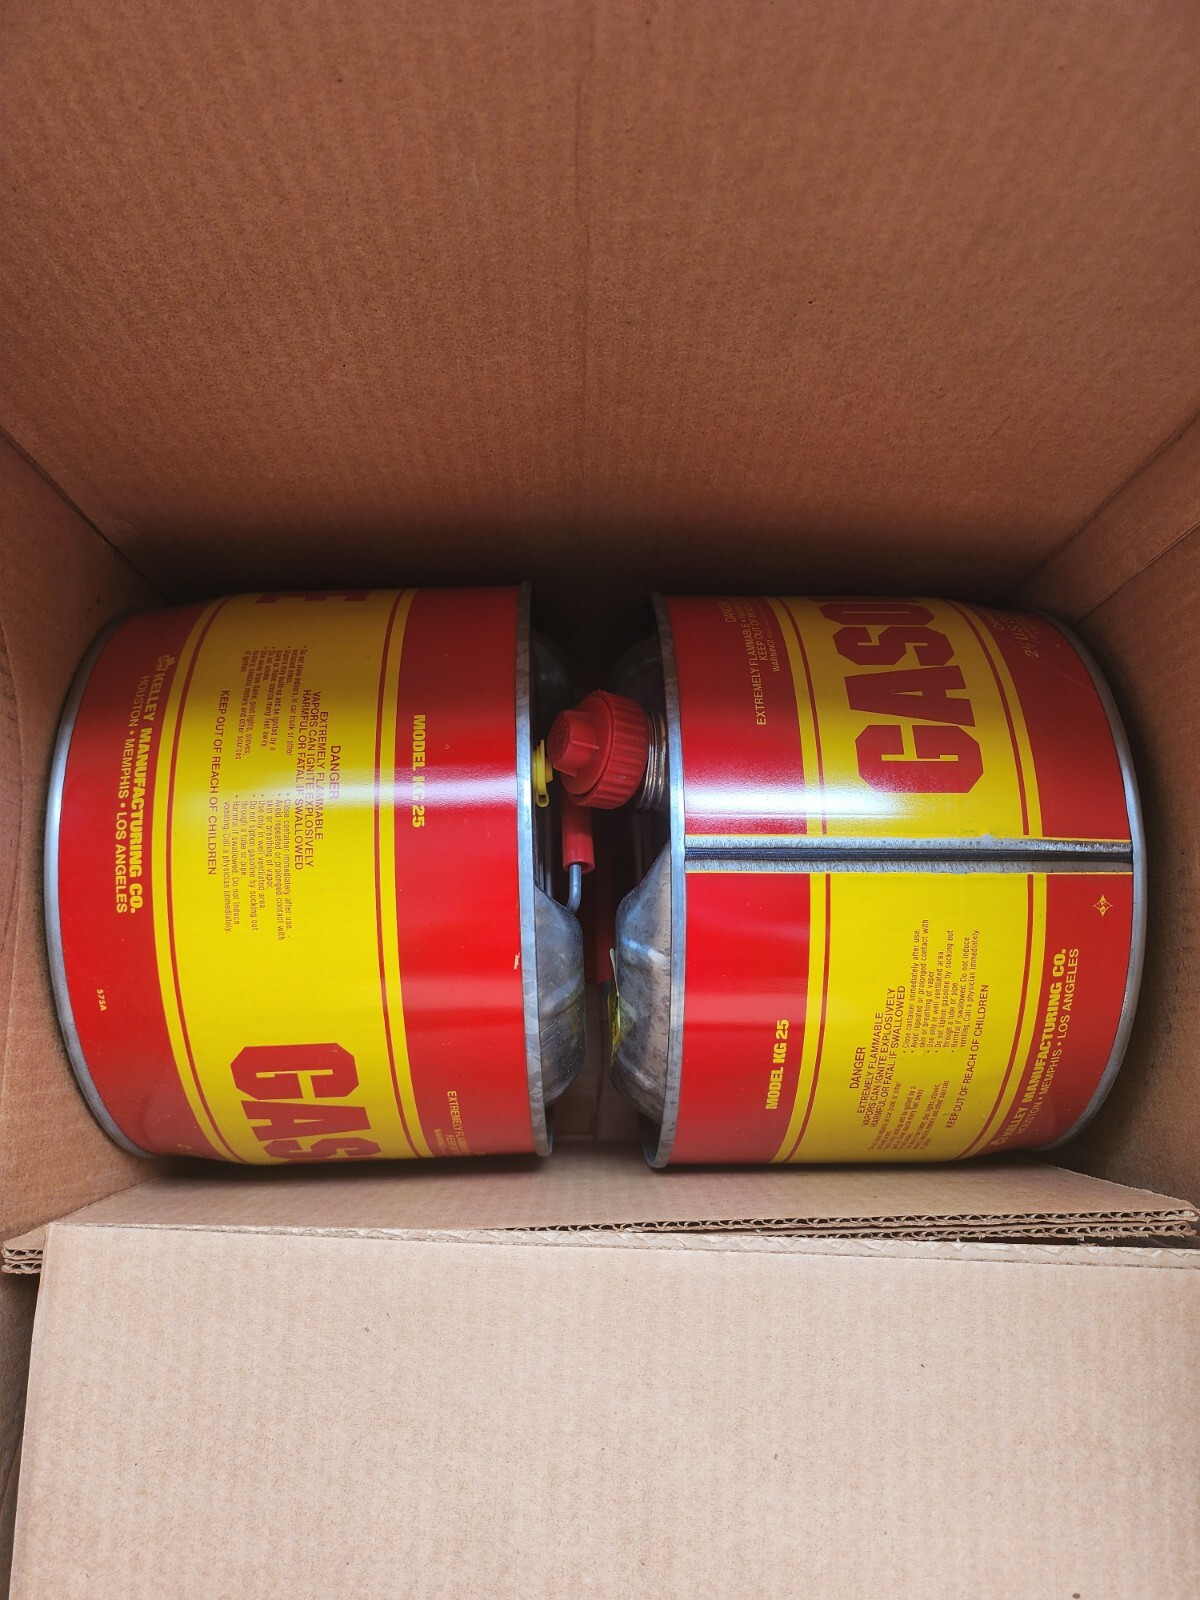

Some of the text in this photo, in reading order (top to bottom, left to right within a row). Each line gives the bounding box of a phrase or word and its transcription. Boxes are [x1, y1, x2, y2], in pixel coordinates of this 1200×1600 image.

[741, 623, 758, 666] FLAMMABLE
[750, 668, 766, 725] EXTREMELY
[298, 690, 311, 733] HARMFUL
[298, 735, 306, 749] OR
[296, 753, 305, 782] FATAL
[305, 692, 321, 867] VAPORS CAN IGNITE EXPLOSIVELY
[315, 712, 328, 840] EXTREMELY FLAMMABLE
[330, 746, 341, 799] DANGER
[412, 715, 425, 828] MODEL KG 25
[115, 675, 150, 913] HOUSTON MEMPHIS LOS ANGELES
[129, 672, 165, 913] KELLEY MANUFACTURING CO.
[208, 690, 230, 875] KEEP OUT OF REACH OF CHILDREN
[296, 786, 303, 795] IF
[240, 801, 248, 826] through
[250, 801, 257, 809] Do
[258, 801, 266, 813] Use
[266, 800, 274, 813] skin
[248, 824, 256, 846] siphon
[265, 826, 274, 857] breathing
[274, 820, 282, 849] repeated
[294, 799, 303, 870] SWALLOWED
[222, 856, 230, 888] physician
[248, 849, 256, 877] gasoline
[232, 877, 239, 886] Do
[249, 880, 256, 888] by
[274, 862, 282, 895] prolonged
[250, 891, 258, 917] sucking
[276, 898, 284, 923] contact
[1062, 948, 1078, 1011] ANGELES
[96, 989, 107, 1011] 575A
[974, 985, 988, 1036] CHILDREN
[880, 989, 895, 1053] EXPLOSIVELY
[890, 986, 905, 1048] SWALLOWED
[1021, 982, 1062, 1103] MANUFACTURING
[1052, 949, 1066, 977] CO.
[1057, 1015, 1070, 1038] LOS
[970, 1039, 980, 1052] OF
[766, 1020, 789, 1109] MODEL KG 25
[849, 1047, 866, 1088] DANGER
[857, 1013, 883, 1113] EXTREMELY FLAMMABLE
[873, 1056, 887, 1083] IGNITE
[883, 1062, 896, 1084] FATAL
[962, 1054, 977, 1084] REACH
[1039, 1049, 1062, 1094] MEMPHIS
[870, 1086, 881, 1100] CAN
[880, 1086, 890, 1097] OR
[952, 1098, 965, 1111] OUT
[958, 1086, 968, 1096] OF
[870, 1098, 886, 1127] HARMFUL
[945, 1112, 958, 1128] KEEP
